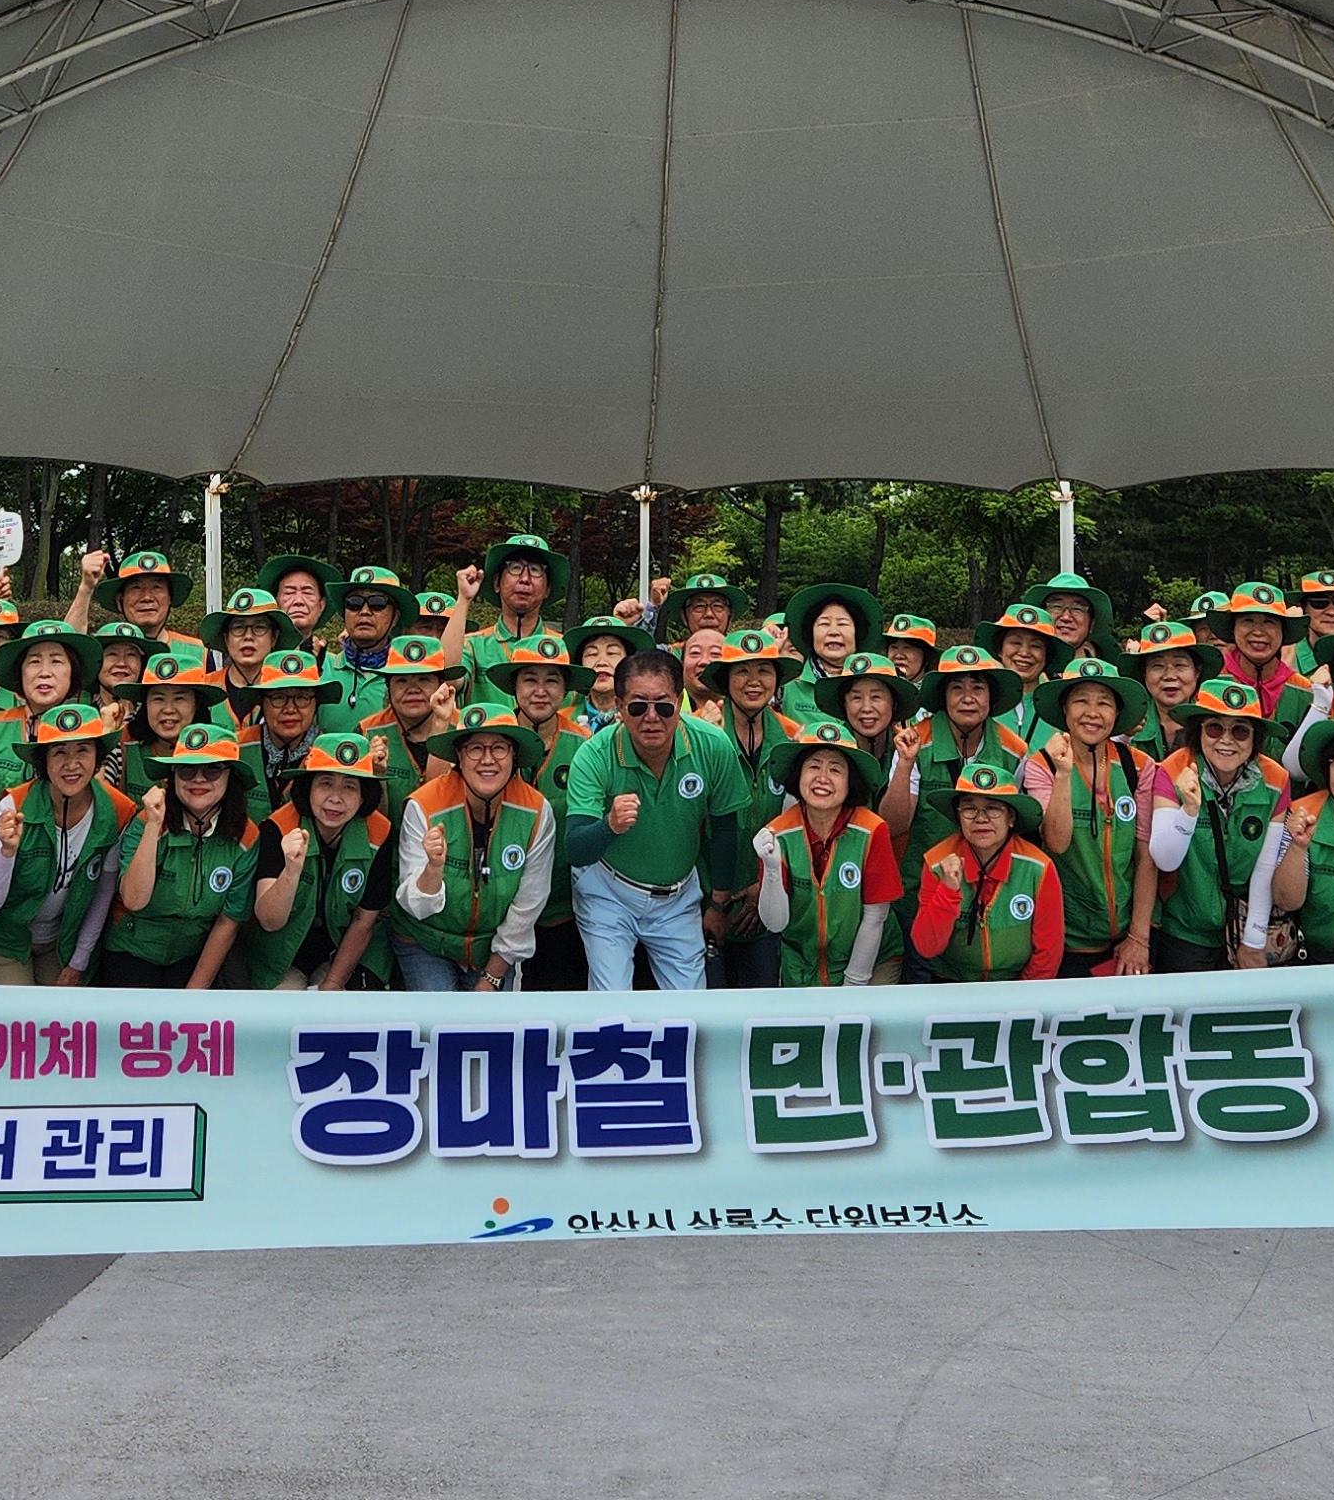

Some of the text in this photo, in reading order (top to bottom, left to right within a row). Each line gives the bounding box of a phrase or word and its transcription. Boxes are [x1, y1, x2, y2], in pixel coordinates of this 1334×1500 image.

[119, 1019, 236, 1078] 방제
[294, 1023, 694, 1157] 장마철
[42, 1117, 165, 1180] 관리
